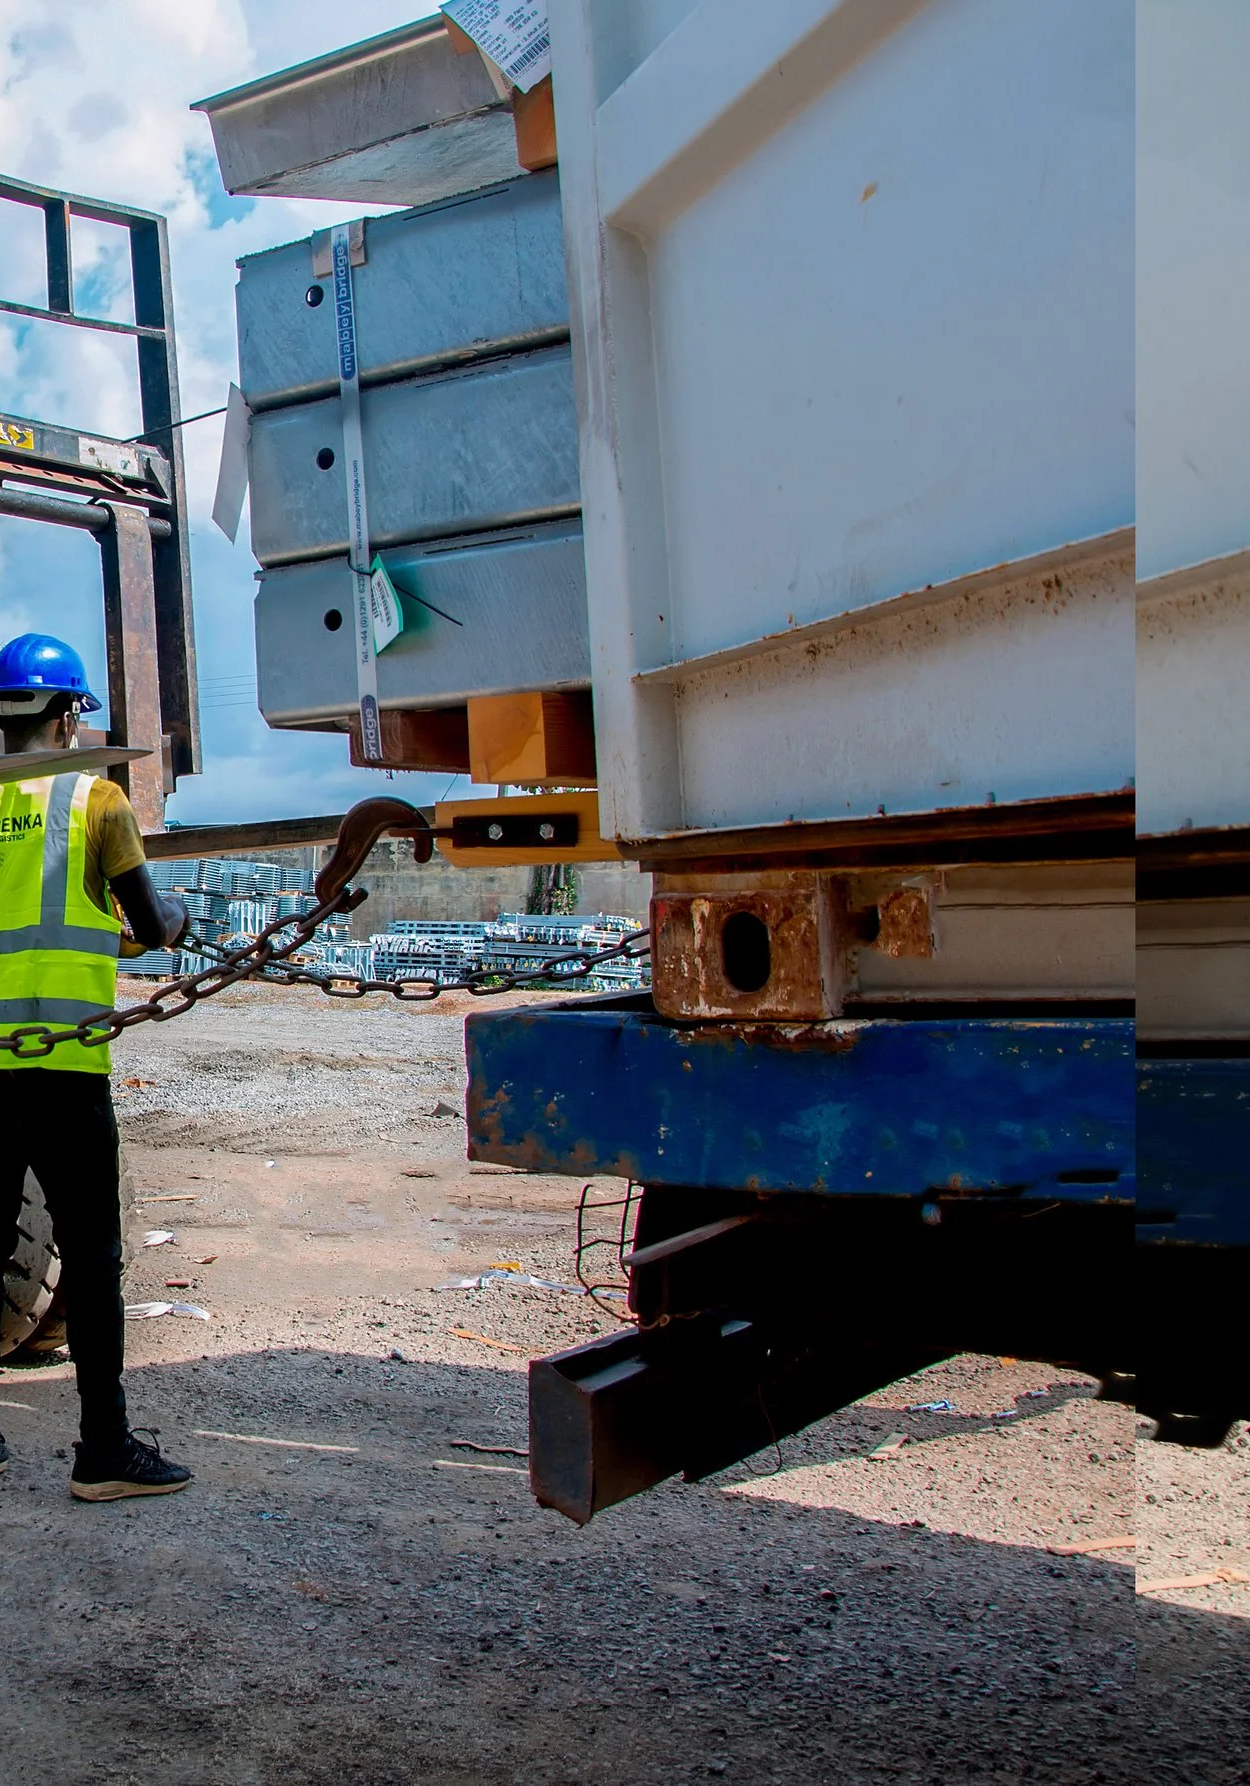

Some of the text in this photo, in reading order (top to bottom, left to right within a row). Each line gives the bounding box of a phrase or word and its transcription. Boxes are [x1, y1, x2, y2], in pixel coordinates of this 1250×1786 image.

[338, 247, 352, 372] mabey bridge
[361, 648, 370, 665] Tel.
